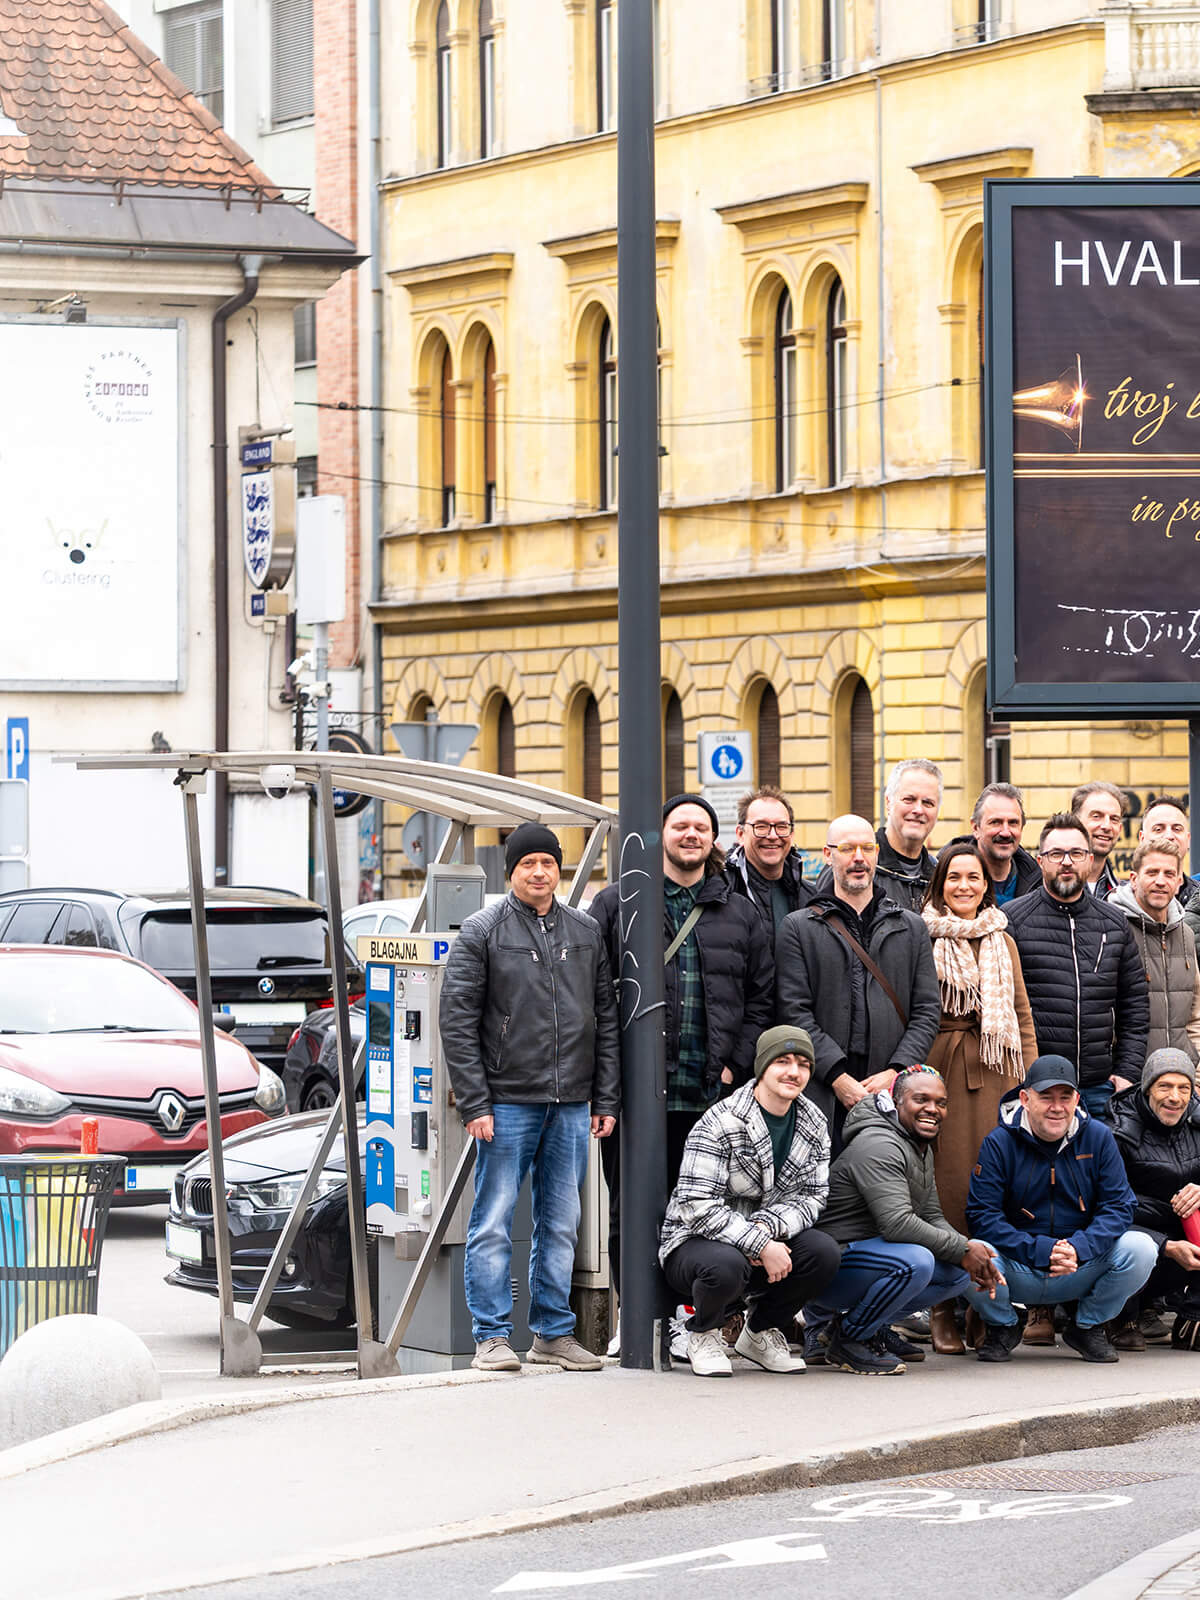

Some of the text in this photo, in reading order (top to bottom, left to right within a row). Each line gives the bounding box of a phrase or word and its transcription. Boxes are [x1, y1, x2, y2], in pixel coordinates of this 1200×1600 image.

[1103, 376, 1178, 446] tvoj
[244, 446, 271, 461] ENGLAND
[1131, 495, 1165, 522] in
[11, 727, 25, 779] P
[370, 940, 419, 961] BLAGAJNA
[433, 940, 450, 961] P
